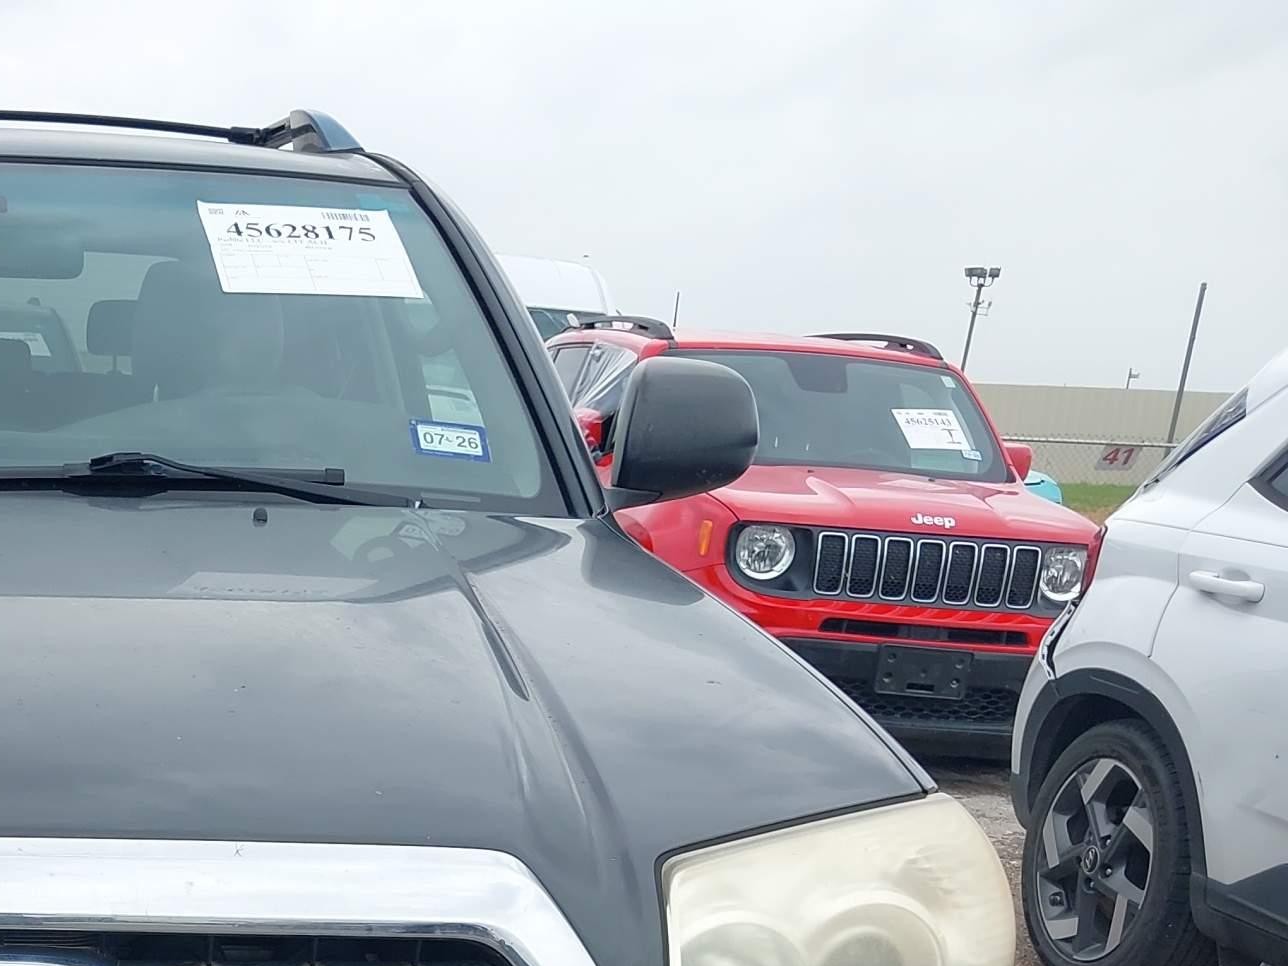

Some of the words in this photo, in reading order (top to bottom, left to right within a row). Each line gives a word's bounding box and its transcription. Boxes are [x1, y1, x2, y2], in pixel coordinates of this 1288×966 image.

[226, 221, 376, 242] 45628175
[423, 431, 445, 446] 07
[455, 435, 479, 450] 26
[1102, 447, 1135, 466] 41
[910, 512, 957, 529] Jeep
